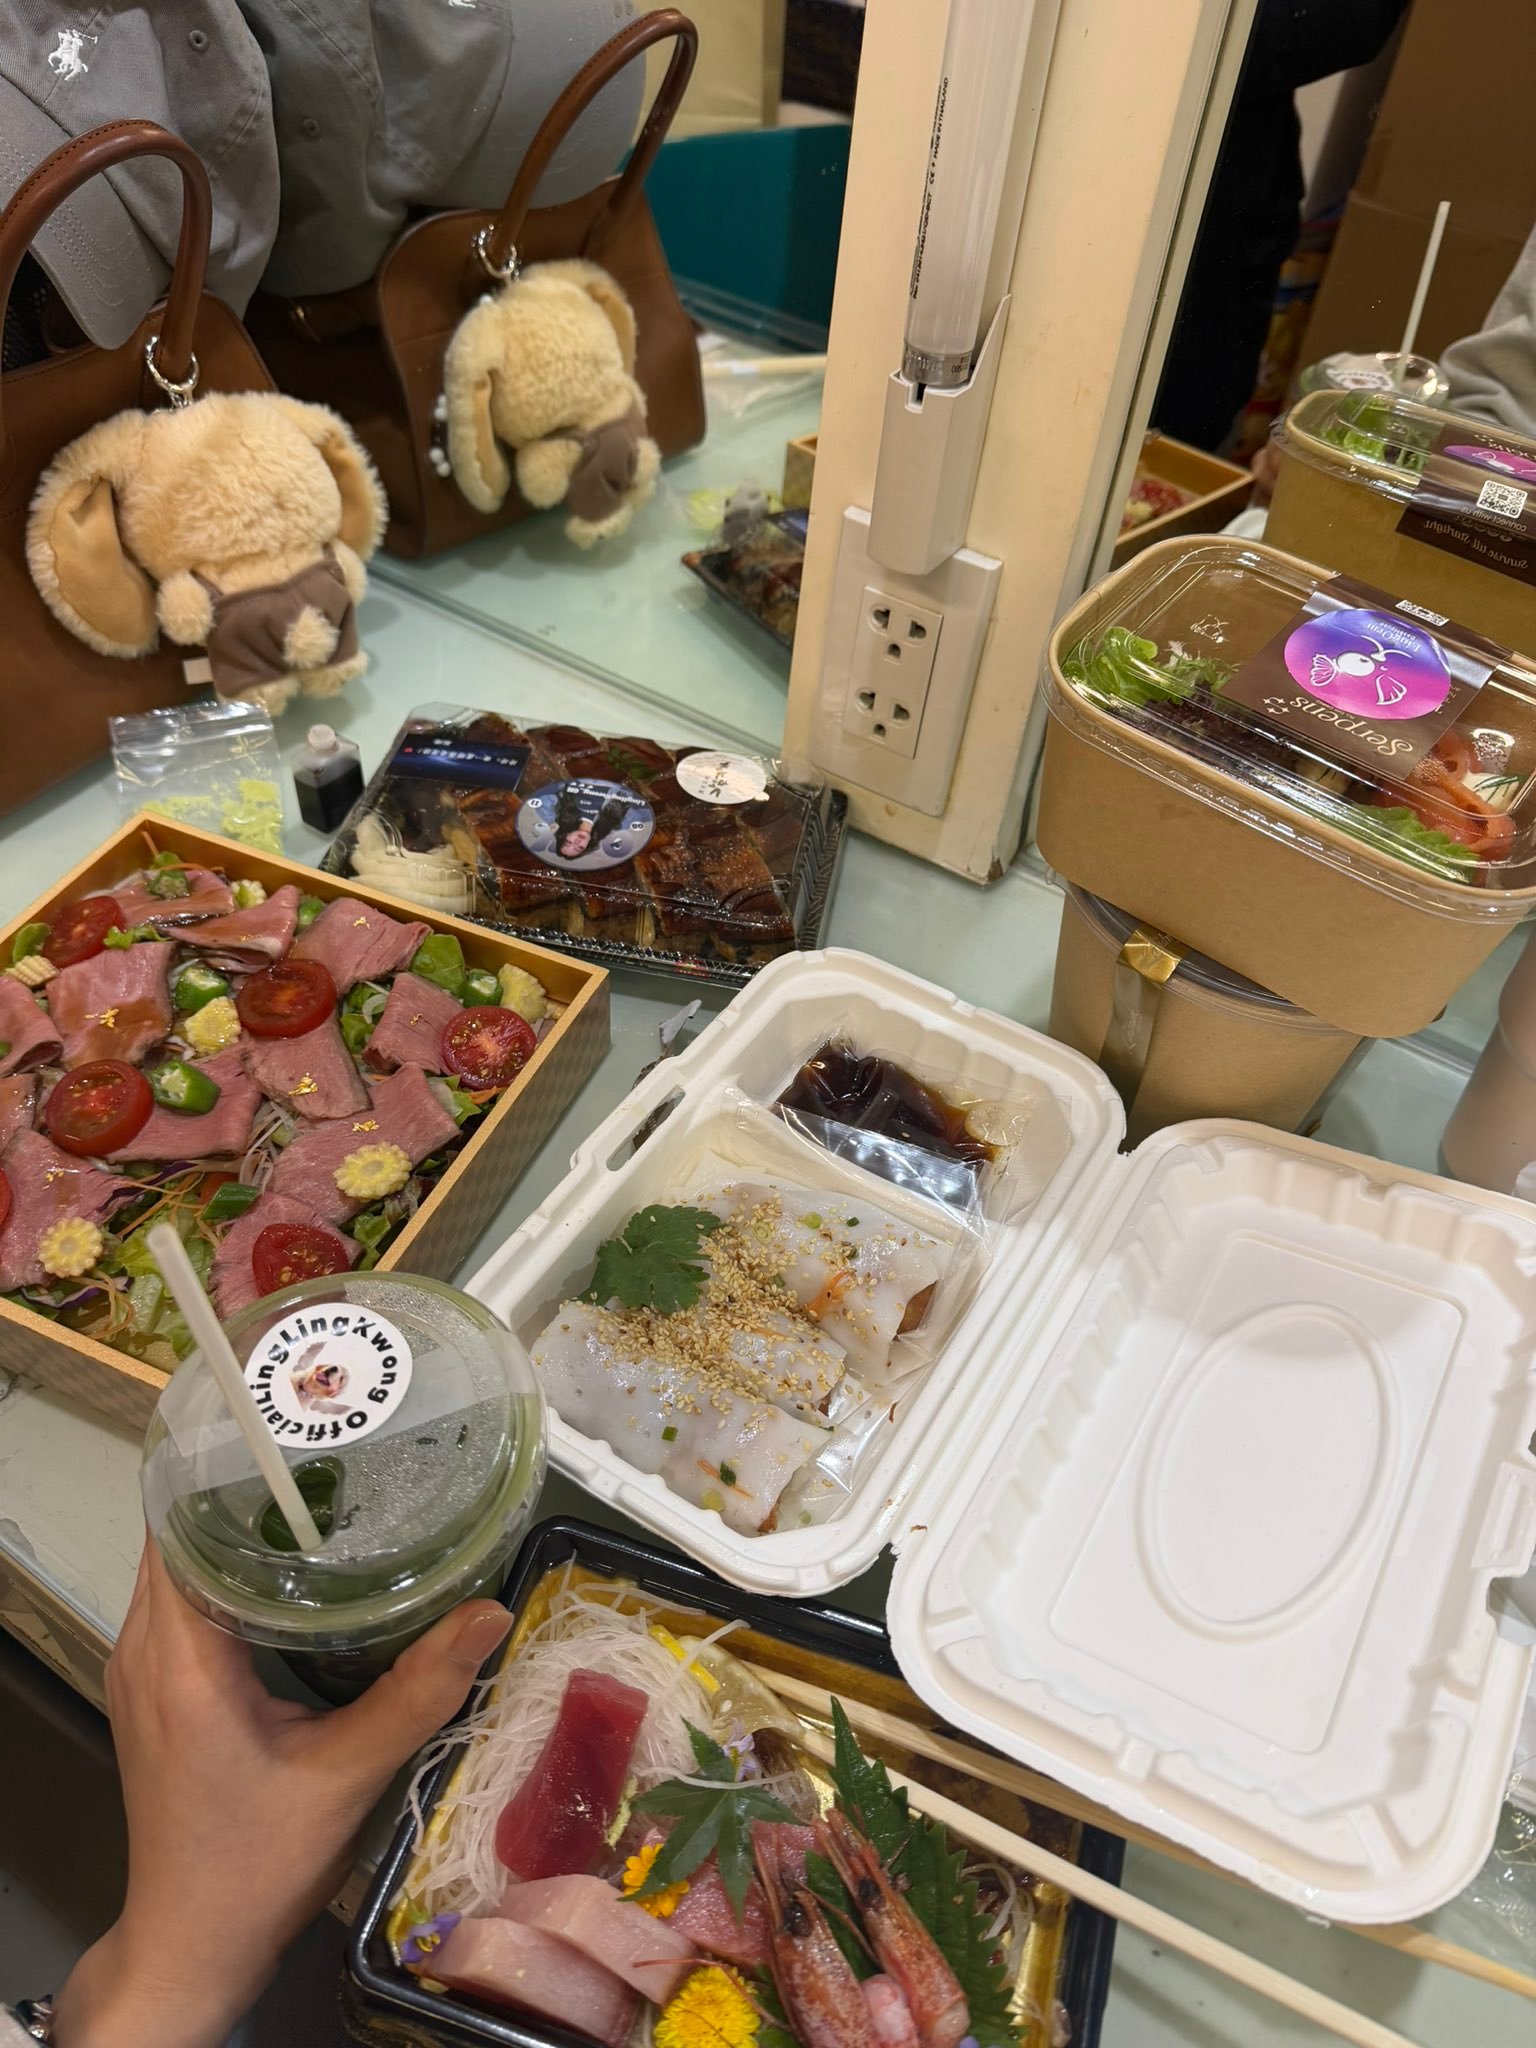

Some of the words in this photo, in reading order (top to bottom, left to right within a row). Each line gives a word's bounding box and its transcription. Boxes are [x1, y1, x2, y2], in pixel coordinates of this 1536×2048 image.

[933, 134, 941, 159] MADE
[938, 77, 949, 121] THAILAND
[1290, 696, 1414, 756] Serpens
